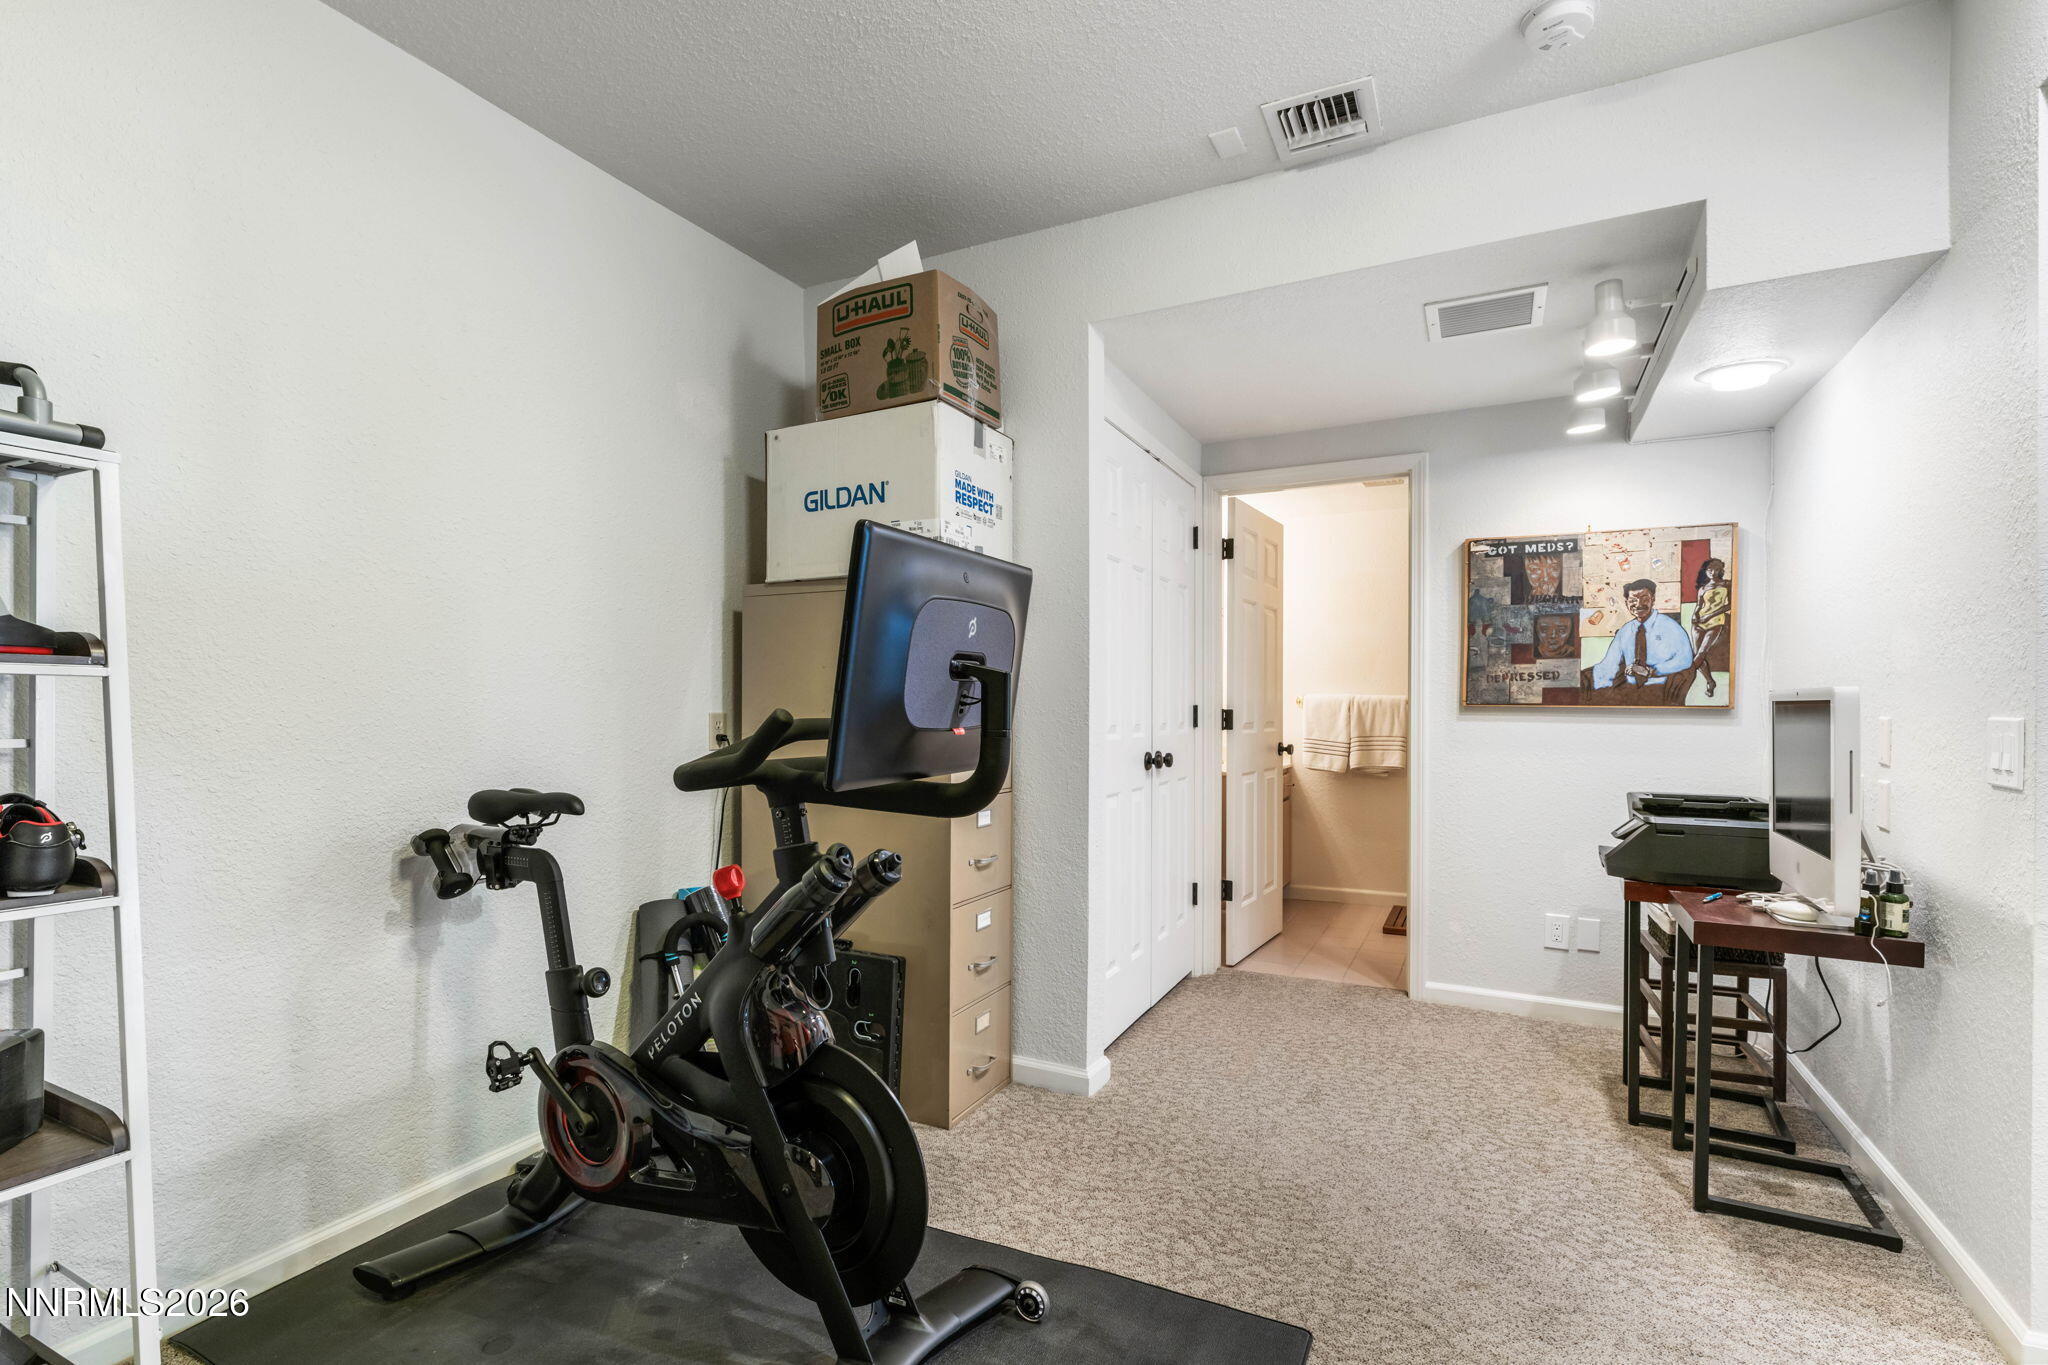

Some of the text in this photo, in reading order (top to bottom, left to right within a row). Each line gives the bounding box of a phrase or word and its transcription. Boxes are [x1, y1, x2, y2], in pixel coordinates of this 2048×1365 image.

[836, 290, 907, 322] U-HAUL
[961, 316, 988, 342] U-HAUL
[820, 342, 842, 360] SMALL
[844, 336, 861, 351] BOX
[829, 388, 848, 402] OK
[803, 481, 885, 513] GILDAN
[954, 478, 994, 503] MADE WITH
[955, 489, 994, 516] RESPECT
[1487, 541, 1574, 556] GOT MEDS?
[1486, 670, 1561, 684] DEPRESSED
[648, 991, 703, 1060] PELOTON
